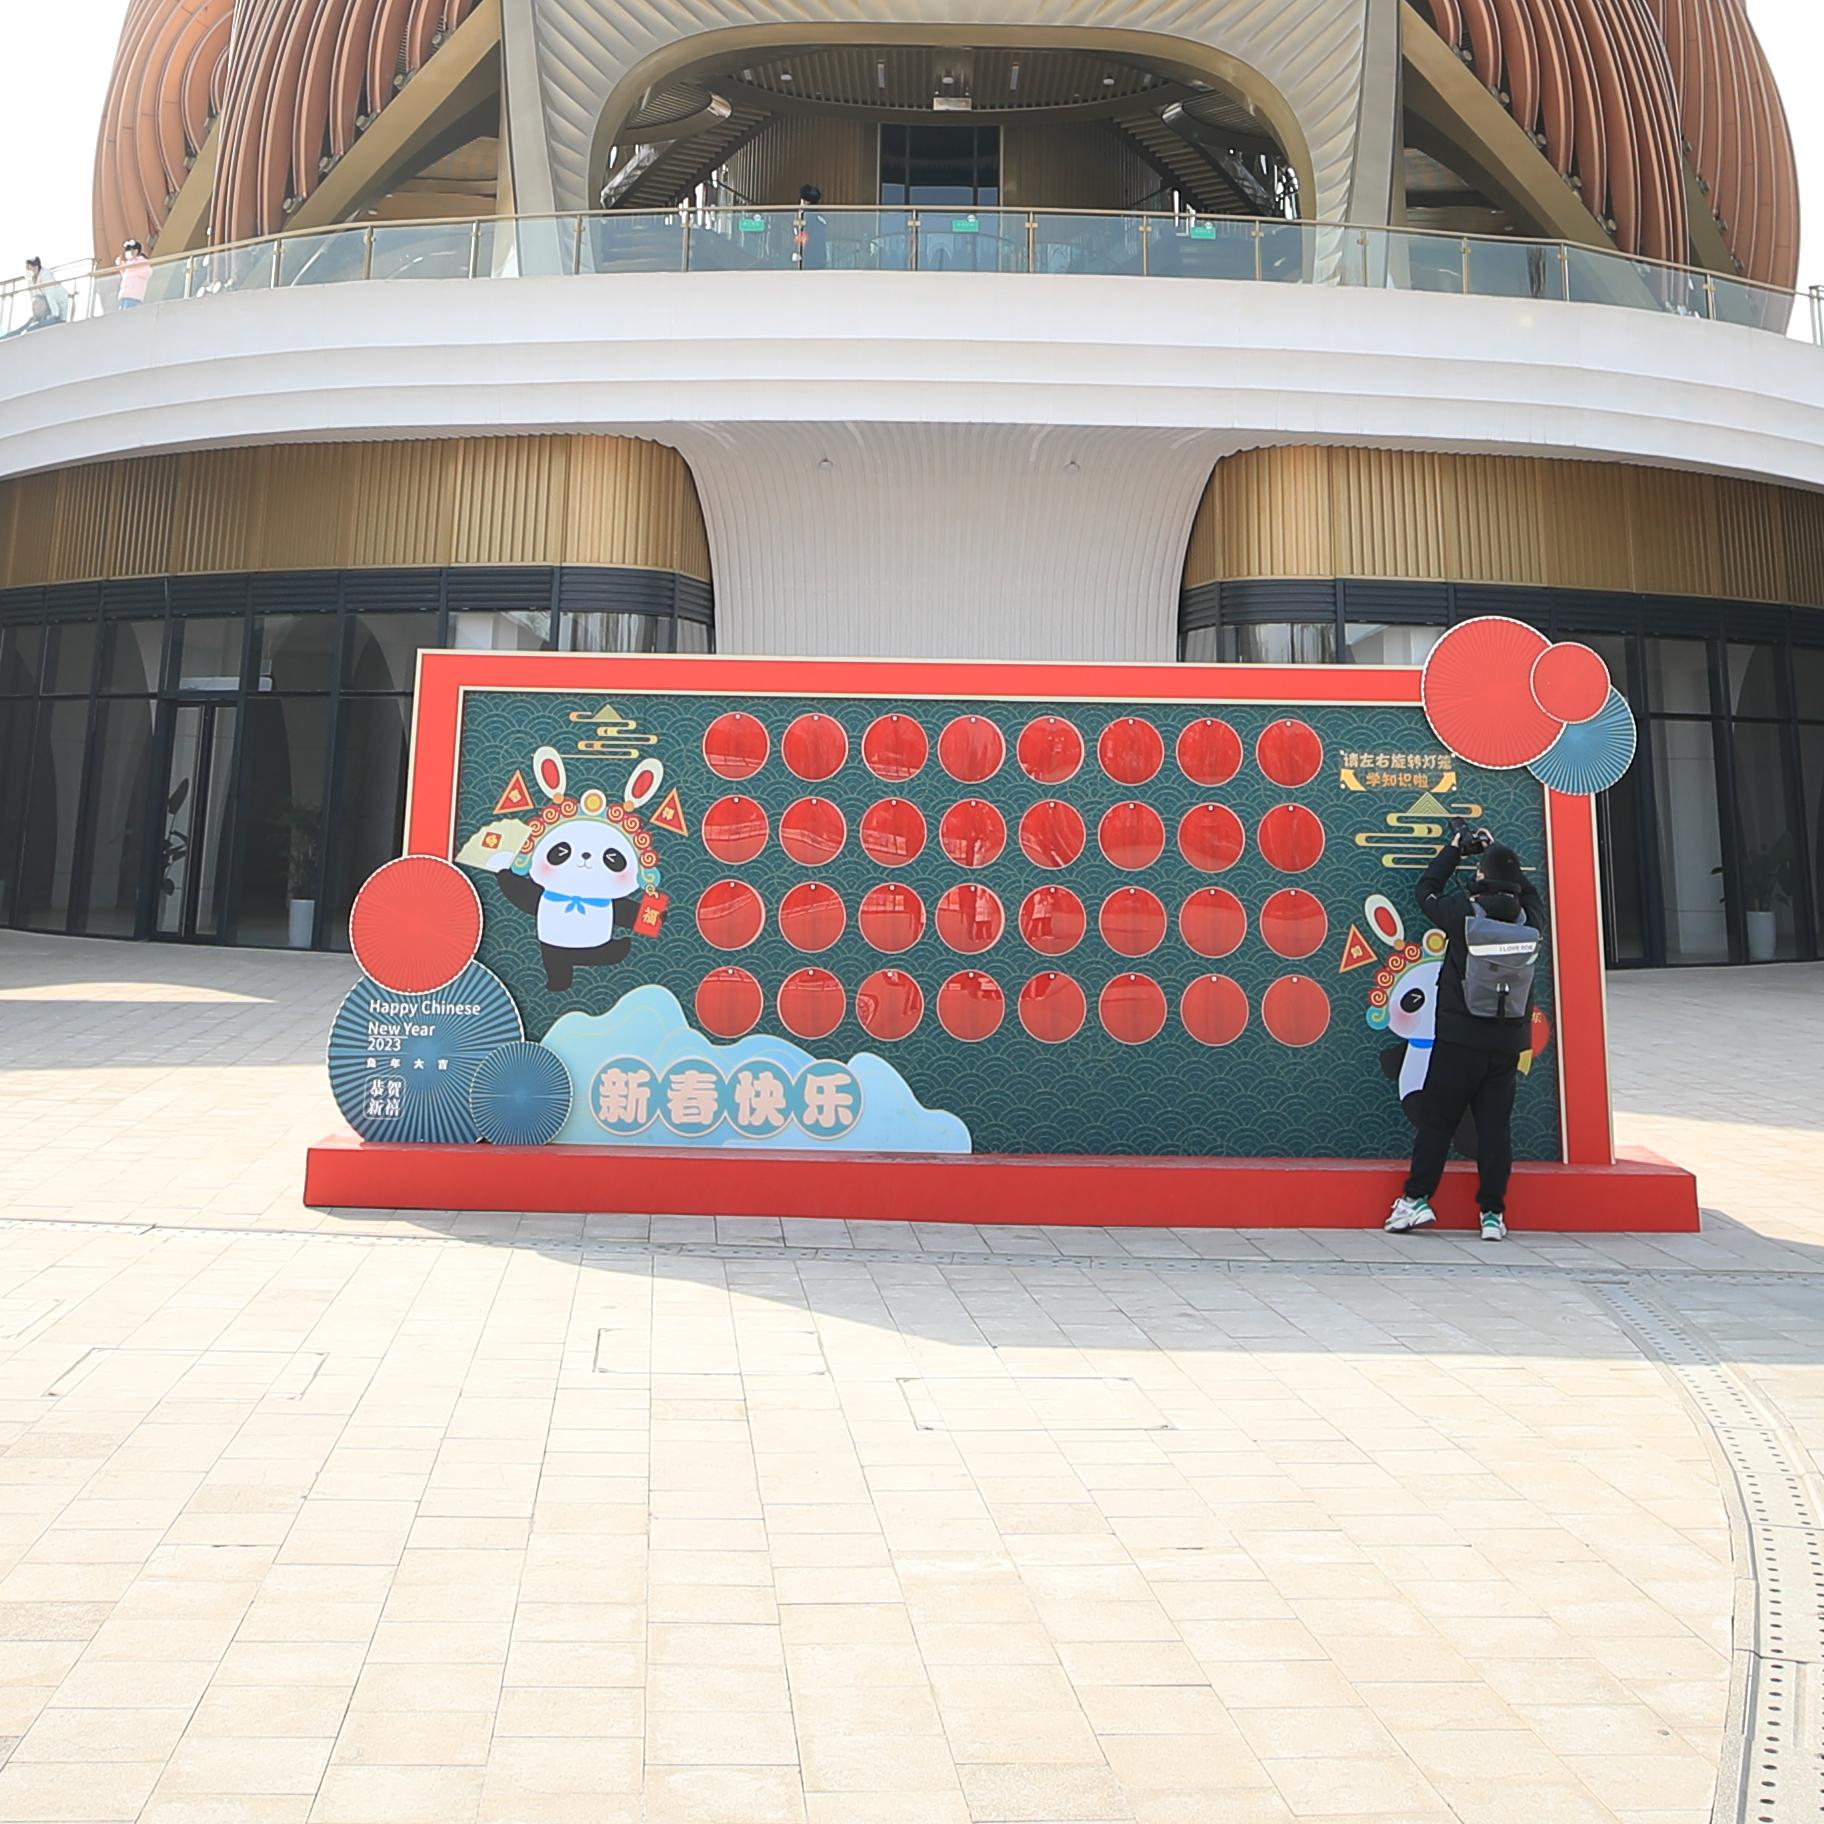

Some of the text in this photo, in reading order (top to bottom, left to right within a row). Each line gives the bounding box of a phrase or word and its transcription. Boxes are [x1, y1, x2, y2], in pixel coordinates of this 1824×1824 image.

[1343, 752, 1453, 770] 请左右旋转灯笼
[1365, 771, 1429, 788] 学知识啦
[369, 999, 481, 1017] Happy Chinese
[368, 1022, 436, 1036] New Year
[367, 1038, 401, 1051] 2023
[366, 1057, 449, 1070] 兔年大吉
[598, 1067, 854, 1128] 新春快乐
